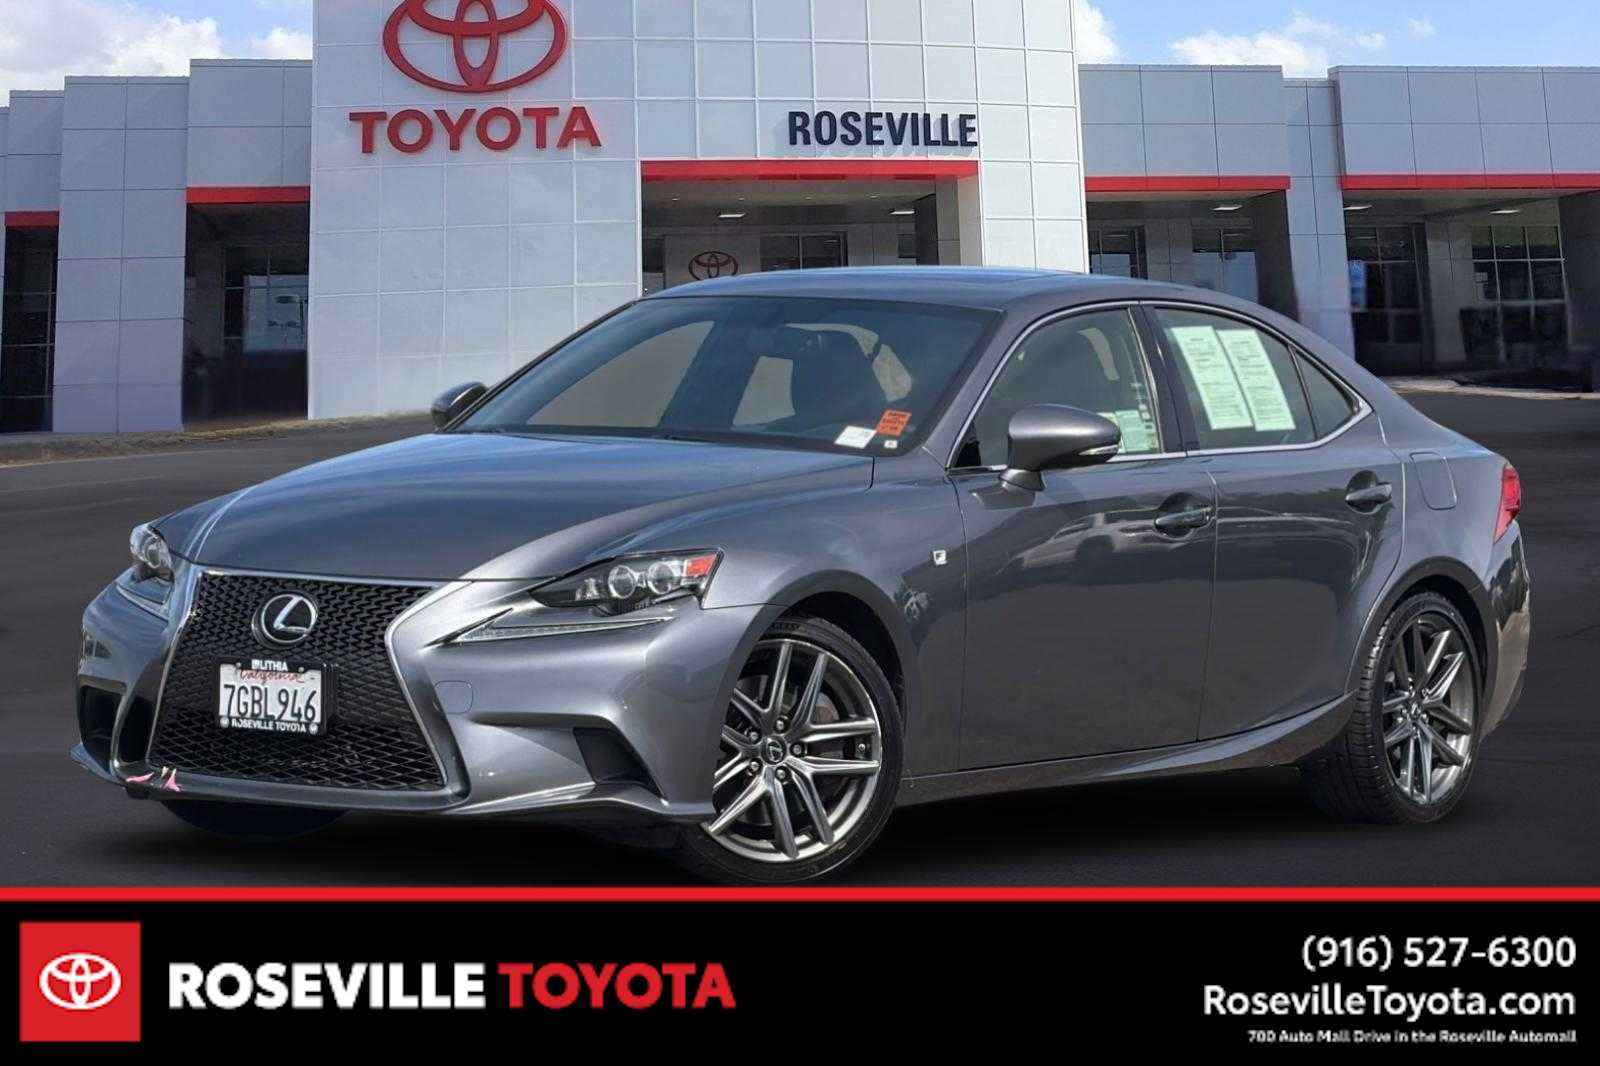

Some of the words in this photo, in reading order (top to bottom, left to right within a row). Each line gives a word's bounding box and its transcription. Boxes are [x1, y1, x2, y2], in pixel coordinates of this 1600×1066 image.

[349, 106, 602, 154] TOYOTA
[788, 110, 979, 148] ROSEVILLE
[224, 684, 317, 722] 7GBL946
[231, 719, 274, 730] ROSEVILLE
[275, 721, 306, 733] TOYOTA
